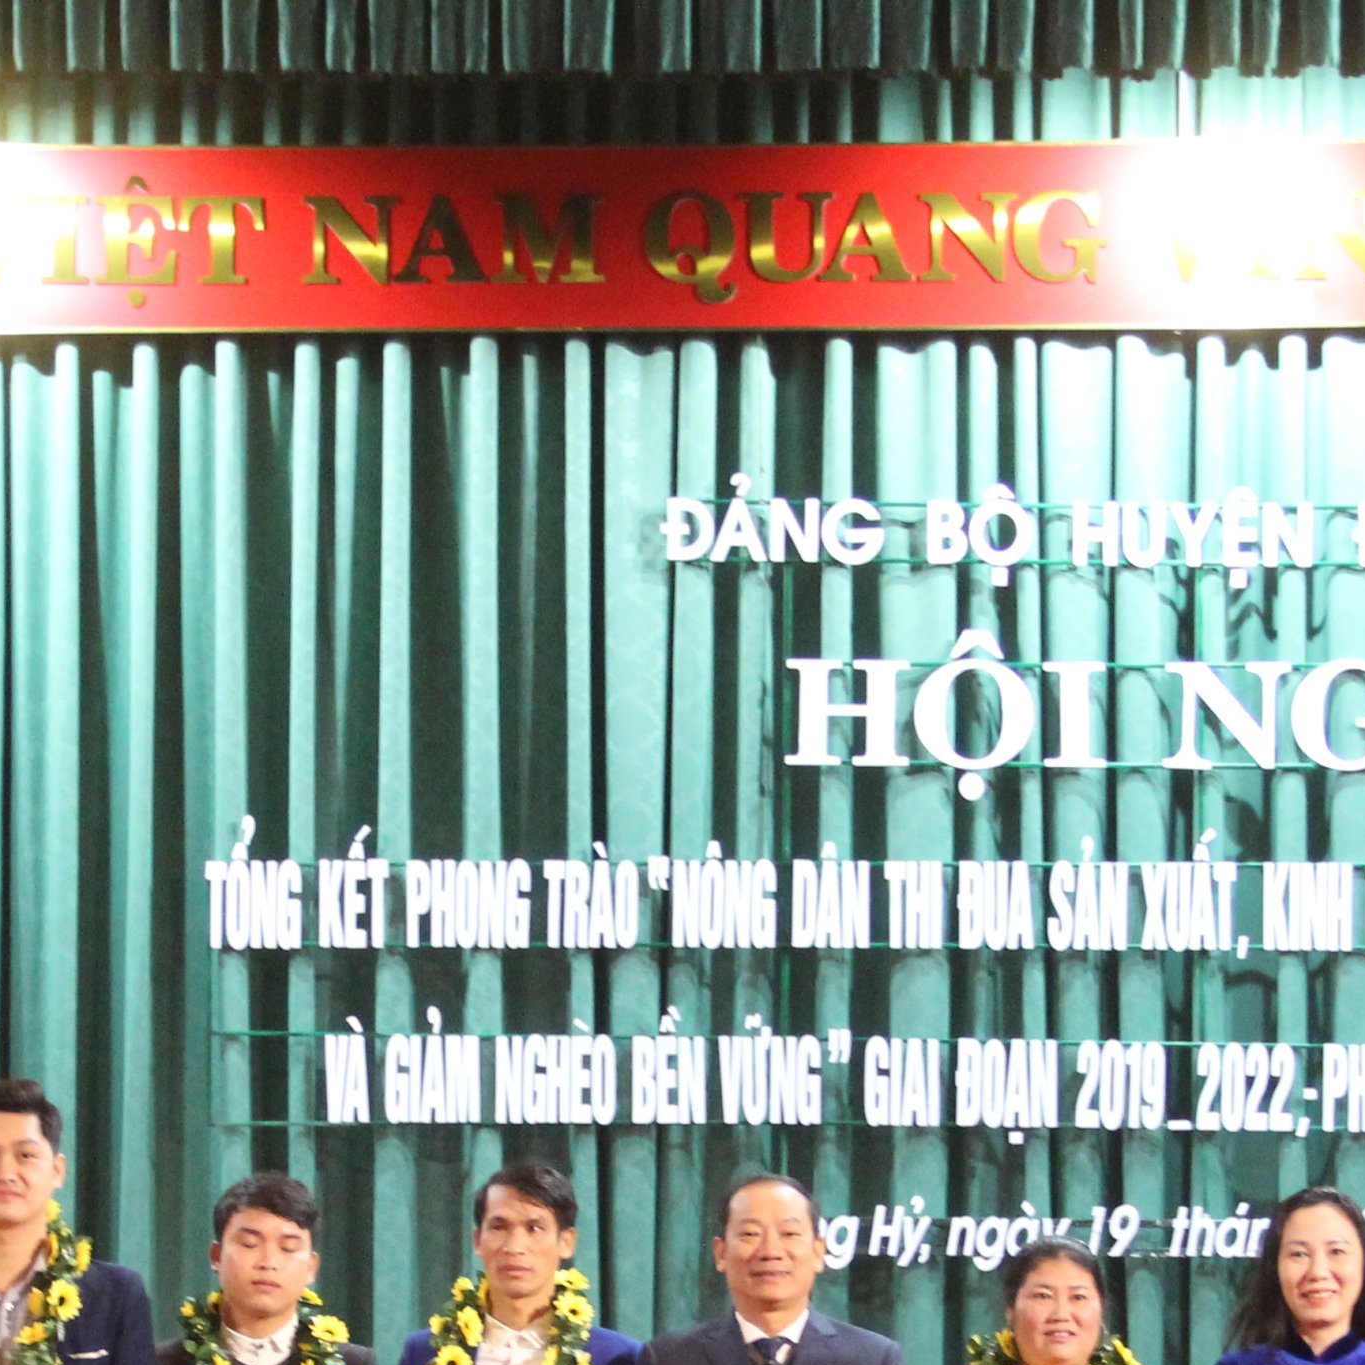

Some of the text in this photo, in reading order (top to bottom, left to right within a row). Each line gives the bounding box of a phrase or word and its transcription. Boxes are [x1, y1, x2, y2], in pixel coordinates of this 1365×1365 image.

[302, 192, 607, 286] NAM
[643, 189, 1108, 304] QUANG
[660, 472, 886, 566] ĐẢNG
[926, 483, 1033, 587] BỘ
[1072, 485, 1315, 590] HUYỆN
[784, 629, 1107, 801] HỘI
[204, 814, 303, 950] TỔNG
[318, 824, 390, 949] KẾT
[406, 858, 531, 950] PHONG
[543, 840, 639, 949] TRÀO
[791, 841, 870, 949] DÂN
[884, 860, 943, 949] THI
[957, 860, 1035, 950] ĐUA
[1047, 836, 1128, 951] SẢN
[1141, 828, 1249, 959] XUẤT,
[1263, 861, 1353, 952] KINH
[324, 1015, 370, 1124] VÀ
[384, 1006, 481, 1124] GIẢM
[495, 1018, 617, 1125] NGHÈO
[632, 1005, 707, 1124] BỀN
[864, 1036, 940, 1127] GIAI
[955, 1037, 1058, 1145] ĐOẠN
[868, 1195, 933, 1267] Hỷ,
[1086, 1204, 1141, 1257] 19
[1169, 1202, 1272, 1257] thán
